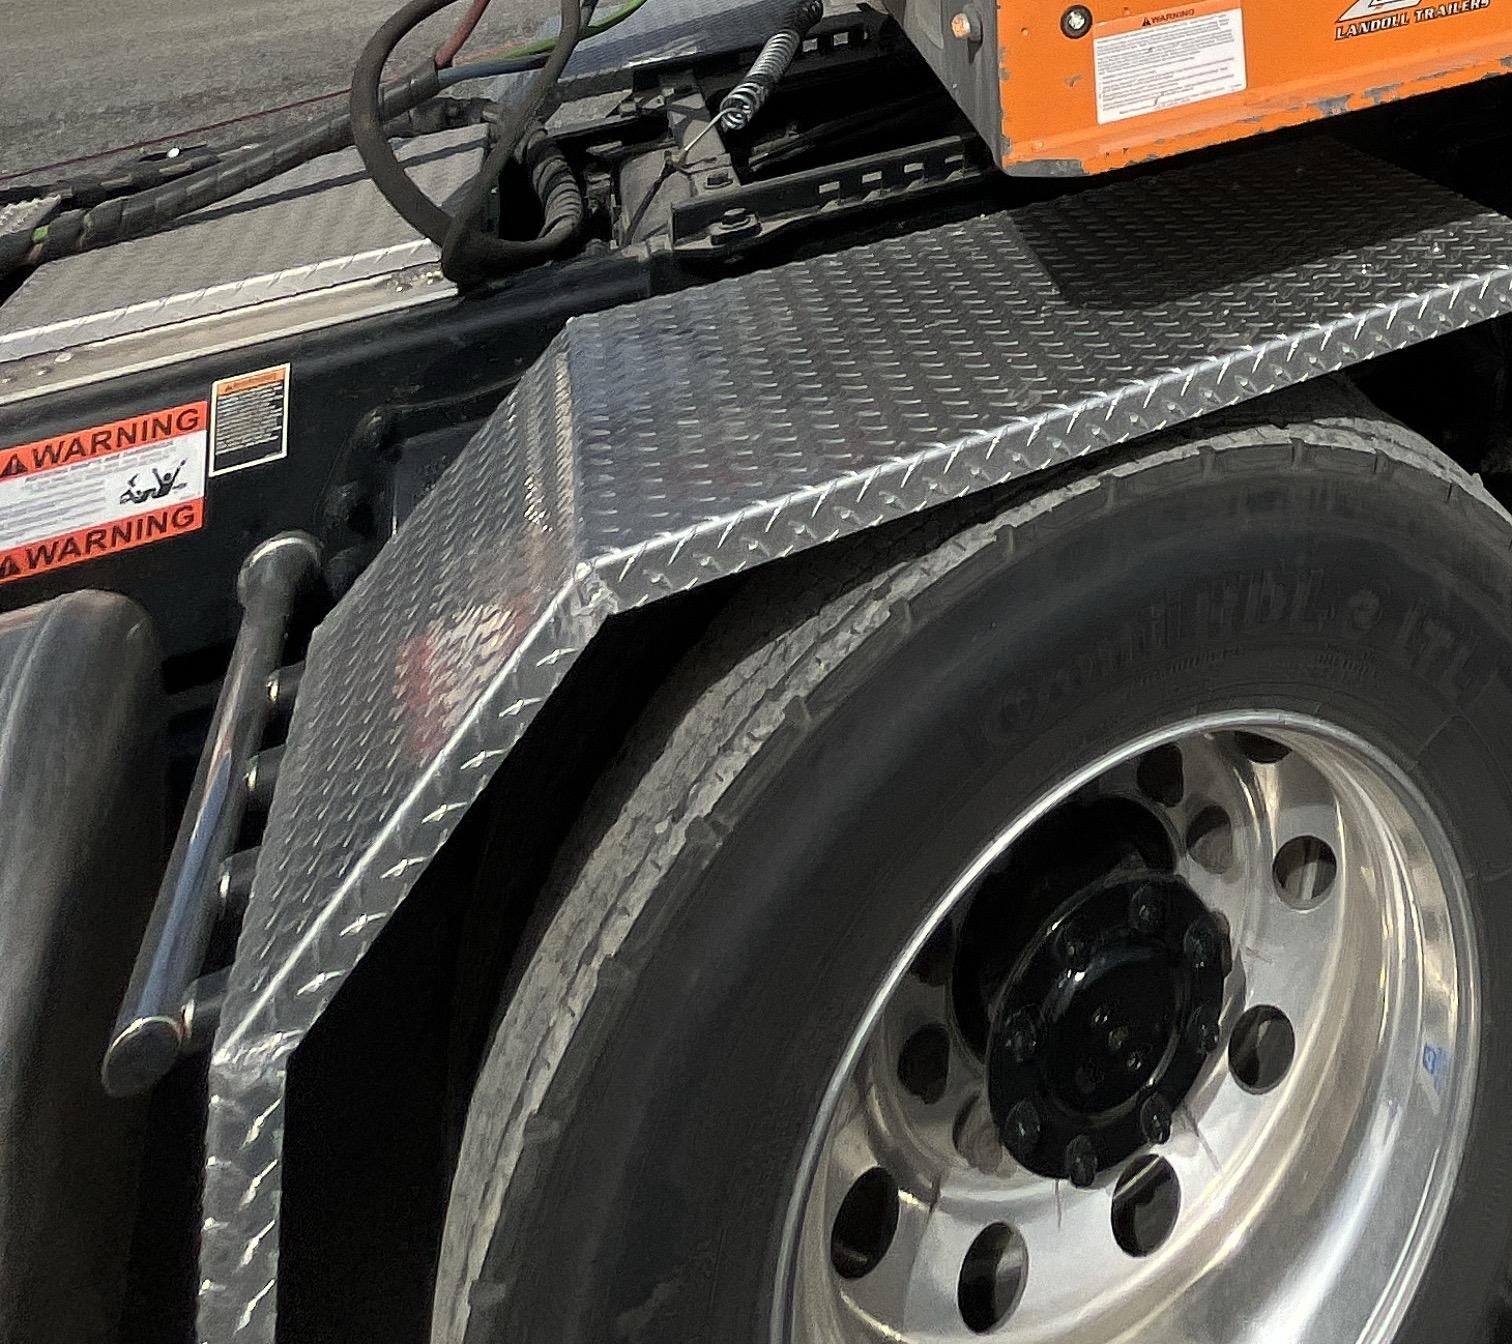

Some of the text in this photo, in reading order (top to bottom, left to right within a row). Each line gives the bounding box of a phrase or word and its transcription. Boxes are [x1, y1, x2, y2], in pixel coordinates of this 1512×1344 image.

[1150, 7, 1196, 25] WARNING
[1334, 10, 1410, 42] LANDOLL
[32, 407, 200, 470] WARNING
[26, 503, 195, 570] WARNING
